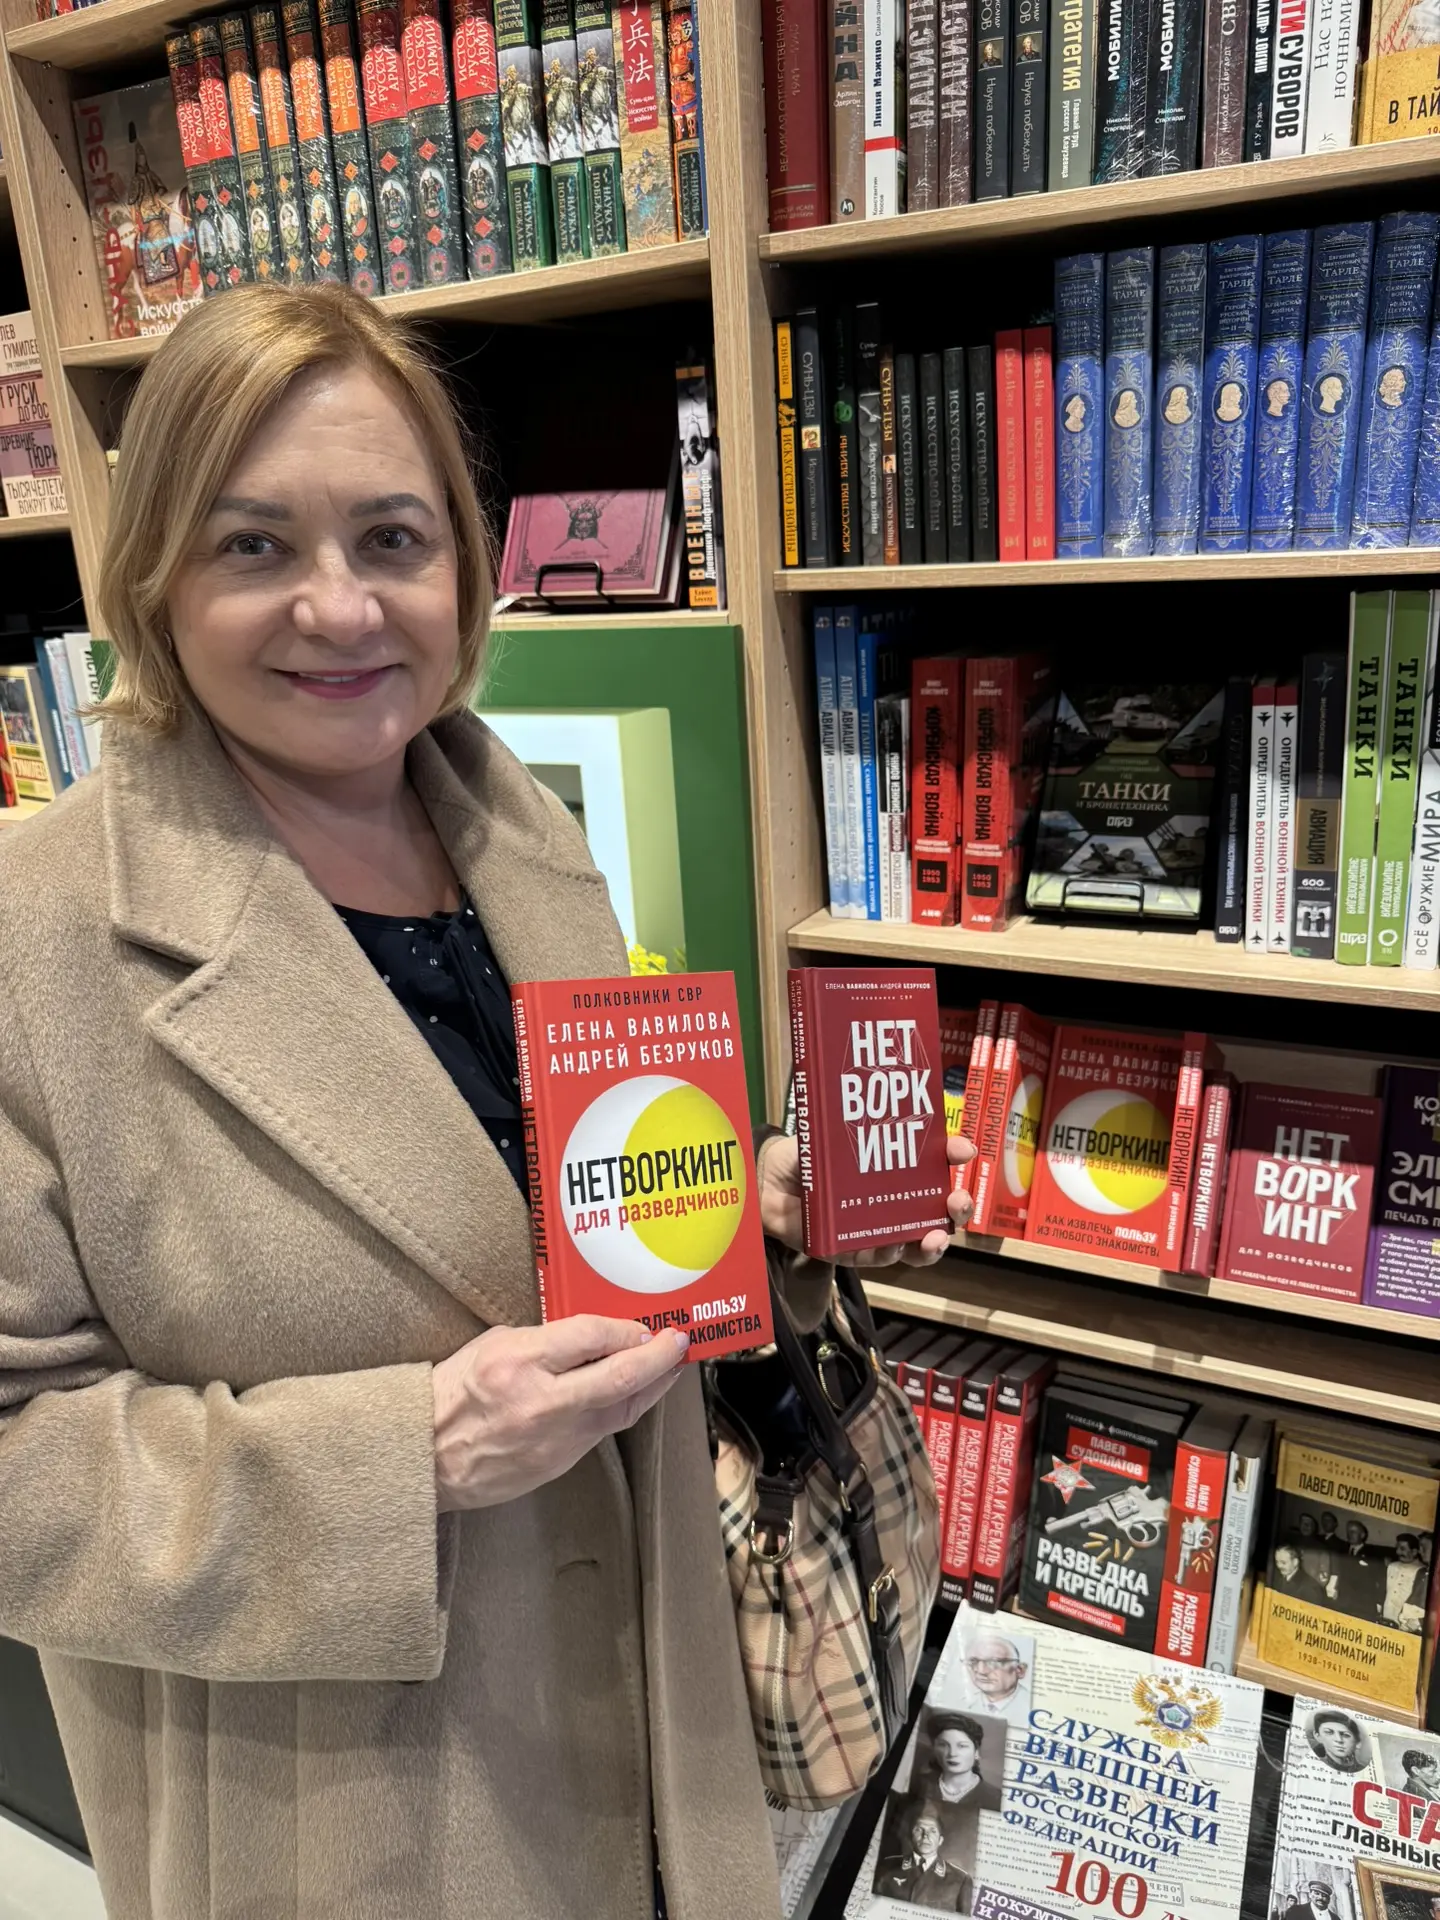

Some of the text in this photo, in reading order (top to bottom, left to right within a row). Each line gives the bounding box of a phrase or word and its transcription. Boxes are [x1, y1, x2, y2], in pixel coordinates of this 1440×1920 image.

[405, 16, 418, 93] ИСТОРИЯ
[415, 15, 428, 88] РУССКОЙ
[426, 19, 440, 76] АРМИИ
[457, 3, 468, 82] ИСТОРИЯ
[467, 2, 479, 77] РУССКОЙ
[478, 8, 491, 65] АРМИИ
[982, 77, 997, 178] Наука побеждать
[1020, 71, 1034, 173] Наука побеждать
[1388, 100, 1399, 125] В
[524, 201, 533, 238] НАУКА
[557, 182, 568, 250] ПОБЕЖДАТЬ
[568, 196, 576, 233] НАУКА
[592, 172, 604, 241] ПОБЕЖДАТЬ
[602, 186, 612, 224] НАУКА
[1166, 284, 1200, 295] ТАРЛЕ
[1219, 277, 1253, 290] ТАРЛЕ
[1267, 274, 1303, 286] ТАРЛЕ
[1323, 267, 1360, 278] ТАРЛЕ
[1387, 258, 1425, 269] ТАРЛЕ
[1113, 289, 1147, 300] ТАРЛЕ
[7, 381, 40, 408] РУСИ
[783, 433, 796, 507] ИСКУССТВО
[901, 394, 916, 530] ИСКУССТВО ВОЙНЫ
[927, 396, 940, 531] ИСКУССТВО ВОЙНЫ
[949, 389, 963, 527] ИСКУССТВО ВОЙНЫ
[975, 391, 989, 529] ИСКУССТВО ВОЙНЫ
[868, 441, 879, 535] Искусство войны
[787, 511, 797, 553] ВОЙНЫ
[1353, 656, 1379, 779] ТАНКИ
[1390, 658, 1419, 781] ТАНКИ
[925, 706, 942, 787] КОРЕЙСКАЯ
[975, 706, 995, 789] КОРЕЙСКАЯ
[924, 791, 941, 838] ВОЙНА
[974, 793, 992, 841] ВОЙНА
[1079, 781, 1172, 801] ТАНКИ
[1252, 736, 1269, 923] ОПРЕДЕЛИТЕЛЬ ВОЕННОЙ ТЕХНИКИ
[1274, 736, 1292, 924] ОПРЕДЕЛИТЕЛЬ ВОЕННОЙ ТЕХНИКИ
[1307, 807, 1329, 865] АВИАЦИЯ
[972, 872, 991, 881] 1950
[972, 880, 991, 889] 1953
[1301, 878, 1324, 887] 600
[1346, 857, 1359, 914] ЭНЦИКЛОПЕДИЯ
[1380, 860, 1393, 917] ЭНЦИКЛОПЕДИЯ
[1418, 865, 1436, 924] ОРУЖИЕ
[1415, 928, 1429, 955] ВСЁ
[573, 987, 703, 1009] ПОЛКОВНИКИ СВР
[825, 982, 931, 990] ЕЛЕНА ВАВИЛОВА АНДРЕЙ БЕЗРУКОВ
[515, 998, 533, 1102] ЕЛЕНА ВАВИЛОВА
[547, 1011, 731, 1044] ЕЛЕНА ВАВИЛОВА
[851, 1019, 916, 1068] НЕТ
[549, 1037, 735, 1075] АНДРЕЙ БЕЗРУКОВ
[1058, 1063, 1177, 1092] АНДРЕЙ БЕЗРУКО
[840, 1069, 934, 1122] ВОРК
[795, 1070, 813, 1192] НЕТВОРКИНГ
[857, 1121, 924, 1173] ИНГ
[1050, 1150, 1077, 1165] для
[1052, 1124, 1172, 1166] НЕТВОРКИНГ
[1170, 1108, 1194, 1192] НЕТВОРКИНГ
[1273, 1125, 1349, 1168] НЕТ
[566, 1140, 738, 1206] НЕТВОРКИНГ
[841, 1187, 943, 1209] для разведчиков
[1193, 1143, 1217, 1230] НЕТВОРКИНГ
[1254, 1160, 1360, 1210] ВОРК
[573, 1186, 740, 1236] для разведчиков
[1036, 1225, 1050, 1237] ИЗ
[1051, 1229, 1093, 1245] ЛЮБОГО
[1045, 1214, 1158, 1243] КАК ИЗВЛЕЧЬ ПОЛЬЗУ
[1263, 1200, 1342, 1245] ИНГ
[1384, 1209, 1429, 1226] ПЕЧАТЬ
[692, 1294, 747, 1322] ПОЛЬЗУ
[961, 1428, 982, 1498] РАЗВЕДКА
[995, 1423, 1017, 1495] РАЗВЕДКА
[1071, 1444, 1144, 1476] СУДОПЛАТОВ
[1090, 1436, 1127, 1457] ПАВЕЛ
[960, 1501, 974, 1511] И
[994, 1499, 1005, 1508] И
[1185, 1455, 1201, 1510] СУДОПЛАТОВ
[1197, 1485, 1211, 1512] ПАВЕЛ
[1298, 1472, 1410, 1518] ПАВЕЛ СУДОПЛАТОВ
[952, 1514, 972, 1569] КРЕМЛЬ
[985, 1511, 1005, 1567] КРЕМЛЬ
[1035, 1560, 1145, 1618] И КРЕМЛЬ
[1037, 1538, 1149, 1597] РАЗВЕДКА
[1167, 1590, 1186, 1652] И КРЕМЛЬ
[1180, 1594, 1199, 1657] РАЗВЕДКА
[1272, 1603, 1406, 1658] ХРОНИКА ТАЙНОЙ ВОЙНЫ
[1294, 1630, 1377, 1667] И ДИПЛОМАТИИ
[1298, 1651, 1370, 1683] 1938-1941 ГОДЫ
[1028, 1707, 1191, 1776] СЛУЖБА
[1023, 1732, 1221, 1814] ВНЕШНЕЙ
[1007, 1787, 1182, 1858] РОССИЙСКОЙ
[1015, 1761, 1222, 1848] РАЗВЕДКИ
[1002, 1807, 1159, 1874] ФЕДЕРАЦИИ
[1045, 1851, 1149, 1920] 100
